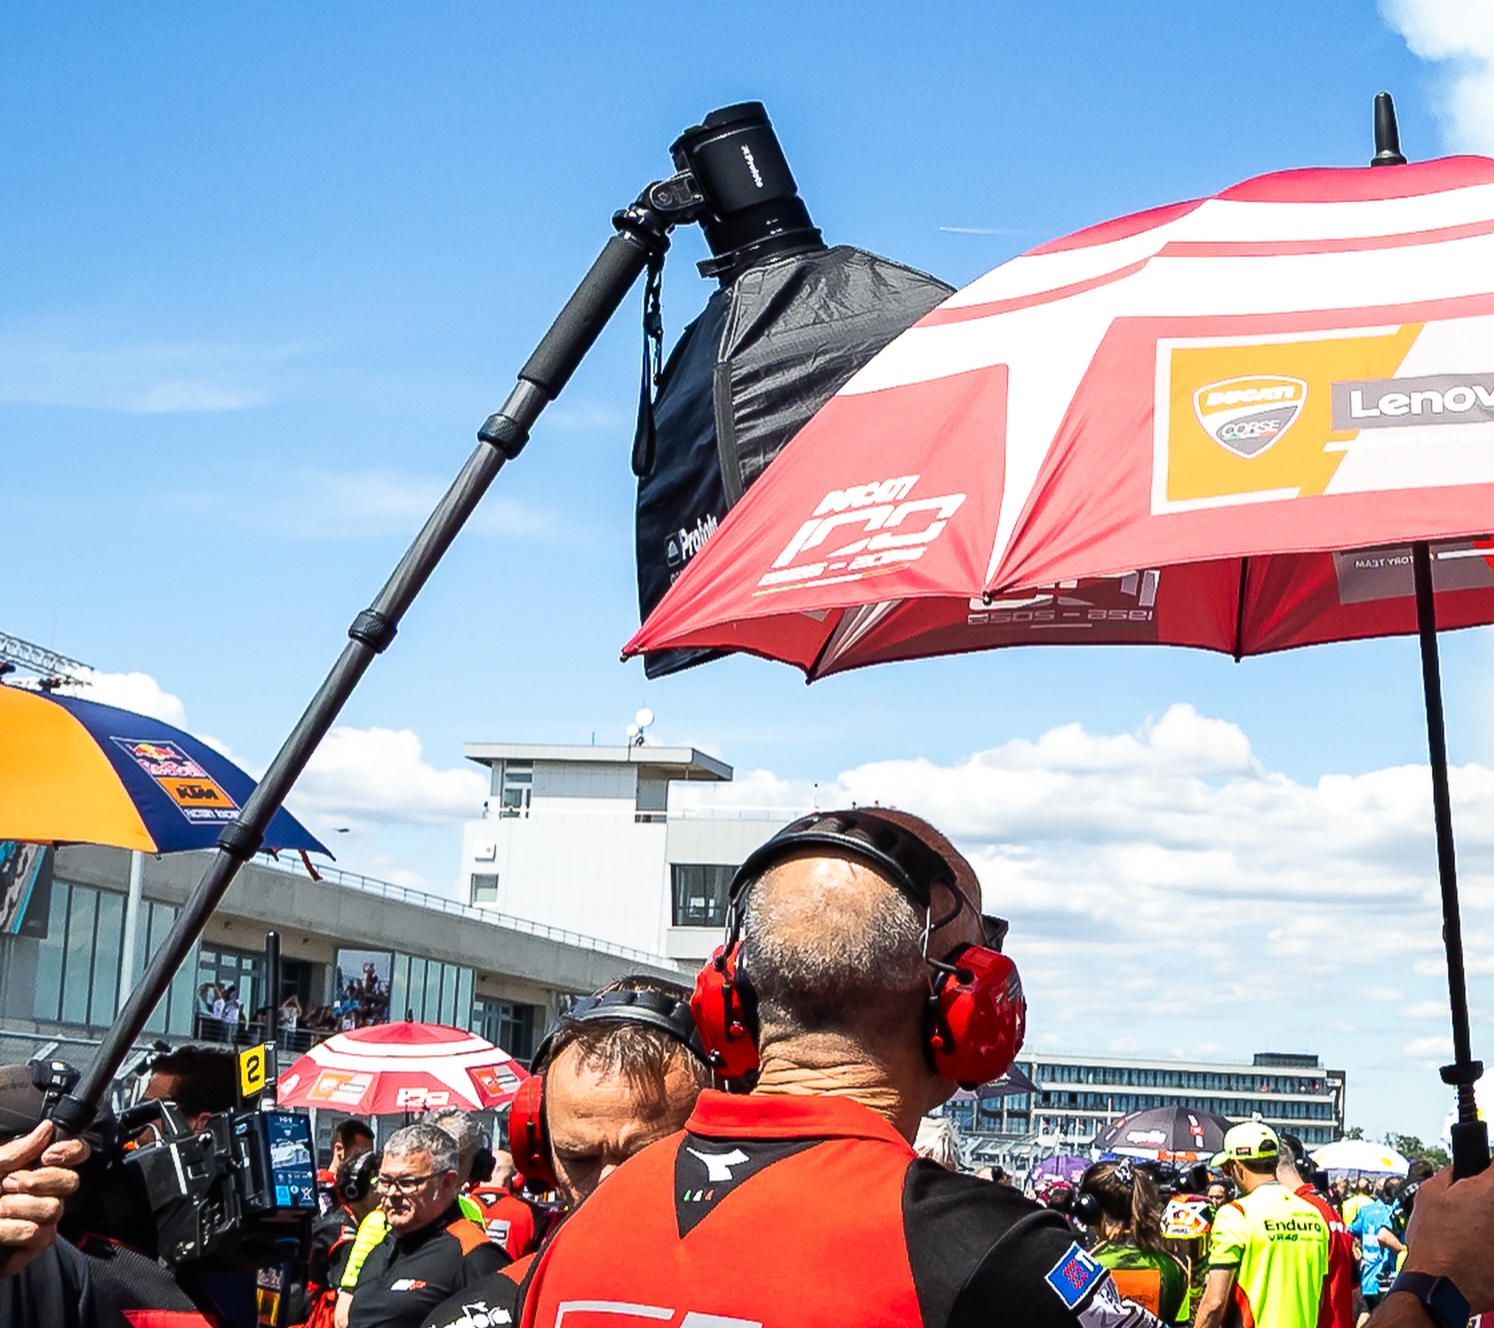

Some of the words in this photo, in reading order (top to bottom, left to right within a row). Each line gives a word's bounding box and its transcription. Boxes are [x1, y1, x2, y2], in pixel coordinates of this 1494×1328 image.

[1206, 386, 1296, 407] DUCATI
[1221, 419, 1282, 439] CORSE
[176, 784, 219, 800] KTM
[247, 1055, 260, 1084] 2
[1264, 1219, 1321, 1232] Enduro
